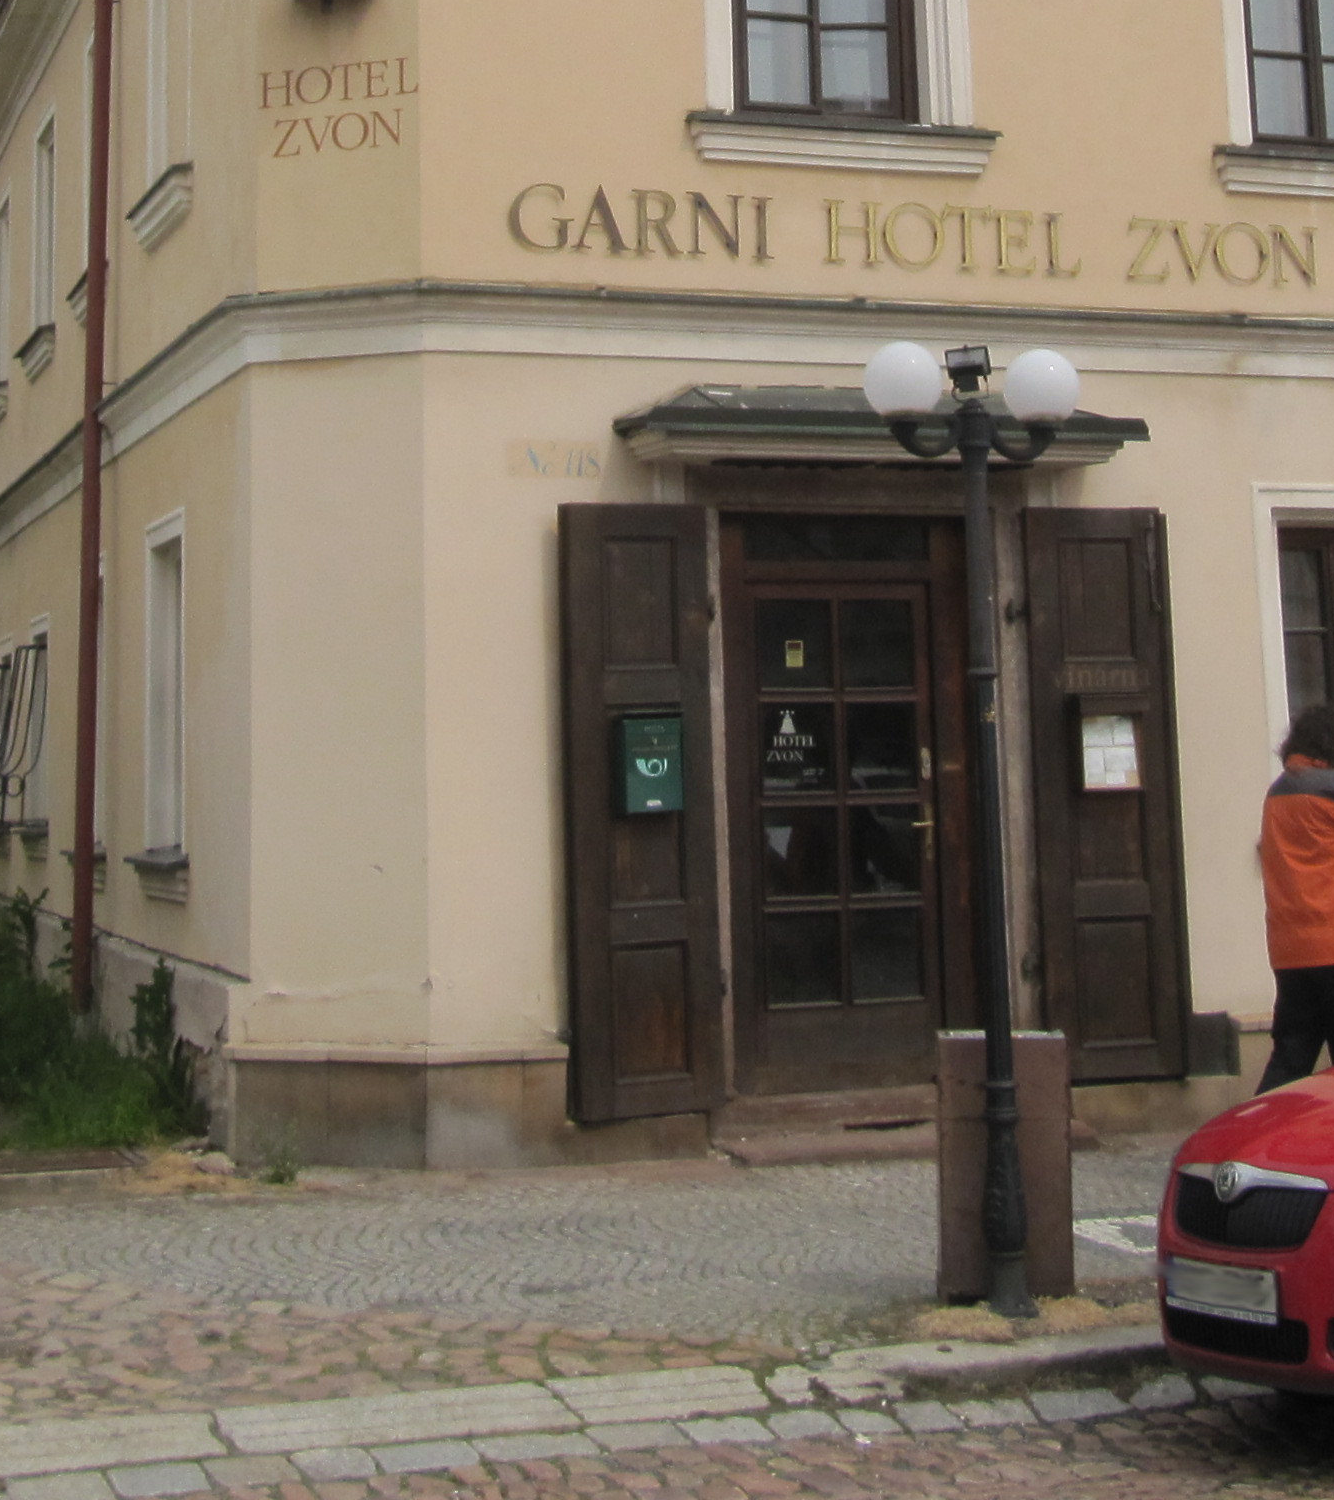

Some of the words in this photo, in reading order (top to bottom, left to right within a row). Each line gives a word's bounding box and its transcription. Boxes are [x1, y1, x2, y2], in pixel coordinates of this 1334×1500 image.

[258, 56, 419, 110] HOTEL
[272, 108, 402, 159] ZVON
[507, 182, 775, 264] GARNI
[823, 197, 1082, 278] HOTEL
[1126, 214, 1320, 289] ZVON
[766, 750, 805, 763] ZVON
[772, 734, 817, 748] HOTEL
